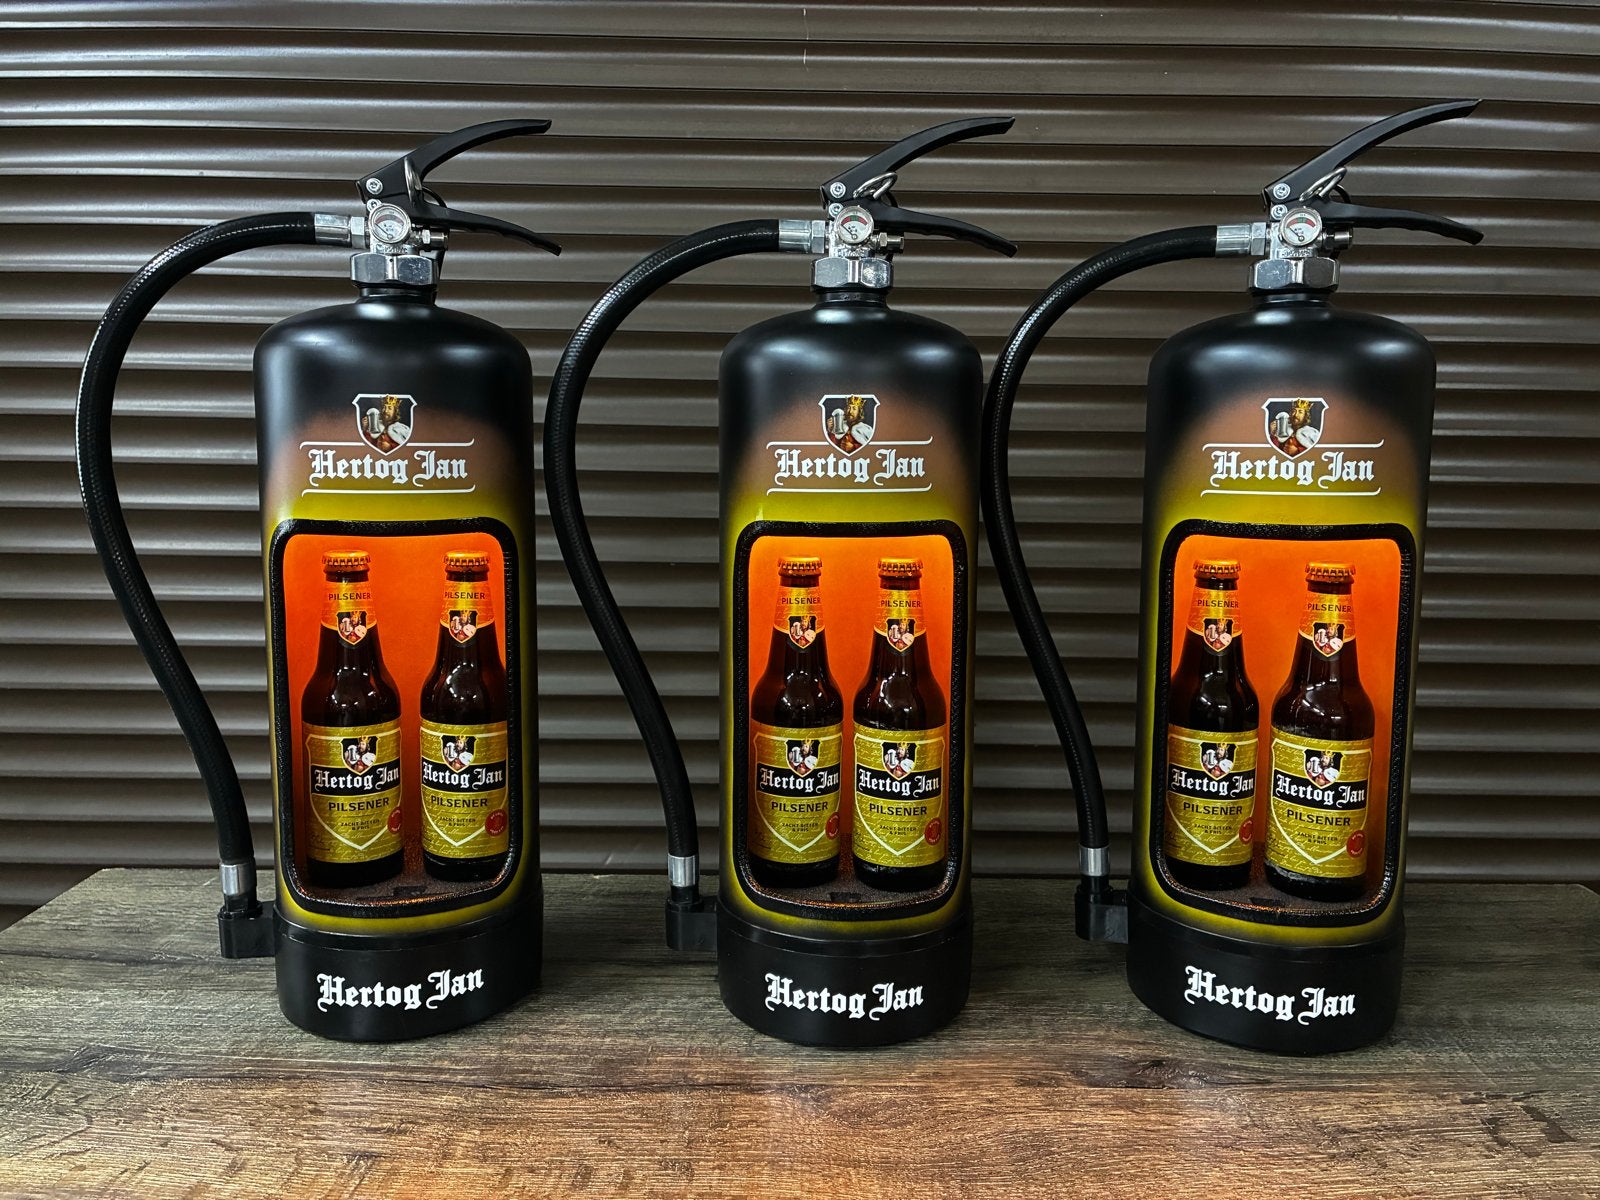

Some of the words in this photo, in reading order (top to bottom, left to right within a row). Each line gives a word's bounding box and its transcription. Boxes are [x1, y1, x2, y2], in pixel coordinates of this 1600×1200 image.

[308, 448, 408, 487] Hertog
[412, 450, 468, 487] Jan
[774, 448, 870, 486] Hertog
[873, 449, 926, 486] Jan
[1210, 450, 1315, 488] Hertog
[1318, 451, 1374, 489] Jan
[328, 592, 371, 601] PILSENER
[444, 591, 486, 600] PILSENER
[781, 597, 821, 605] PILSENER
[880, 599, 921, 608] PILSENER
[1197, 599, 1239, 608] PILSENER
[1307, 603, 1352, 612] PILSENER
[314, 769, 374, 792] Hertog
[375, 766, 399, 790] Jan
[422, 761, 470, 789] Hertog
[472, 768, 503, 790] Jan
[760, 768, 814, 792] Hertog
[816, 770, 839, 794] Jan
[858, 768, 912, 796] Hertog
[913, 775, 940, 798] Jan
[1171, 768, 1229, 796] Hertog
[1230, 776, 1254, 798] Jan
[431, 795, 488, 808] PILSENER
[1275, 774, 1335, 806] Hertog
[1336, 786, 1365, 809] Jan
[328, 797, 390, 812] PILSENER
[771, 801, 829, 813] PILSENER
[869, 802, 927, 816] PILSENER
[1183, 801, 1243, 816] PILSENER
[1286, 809, 1351, 827] PILSENER
[316, 973, 422, 1013] Hertog
[425, 969, 484, 1010] Jan
[764, 972, 867, 1019] Hertog
[868, 982, 924, 1021] Jan
[1184, 965, 1296, 1022] Hertog
[1297, 987, 1356, 1026] Jan
